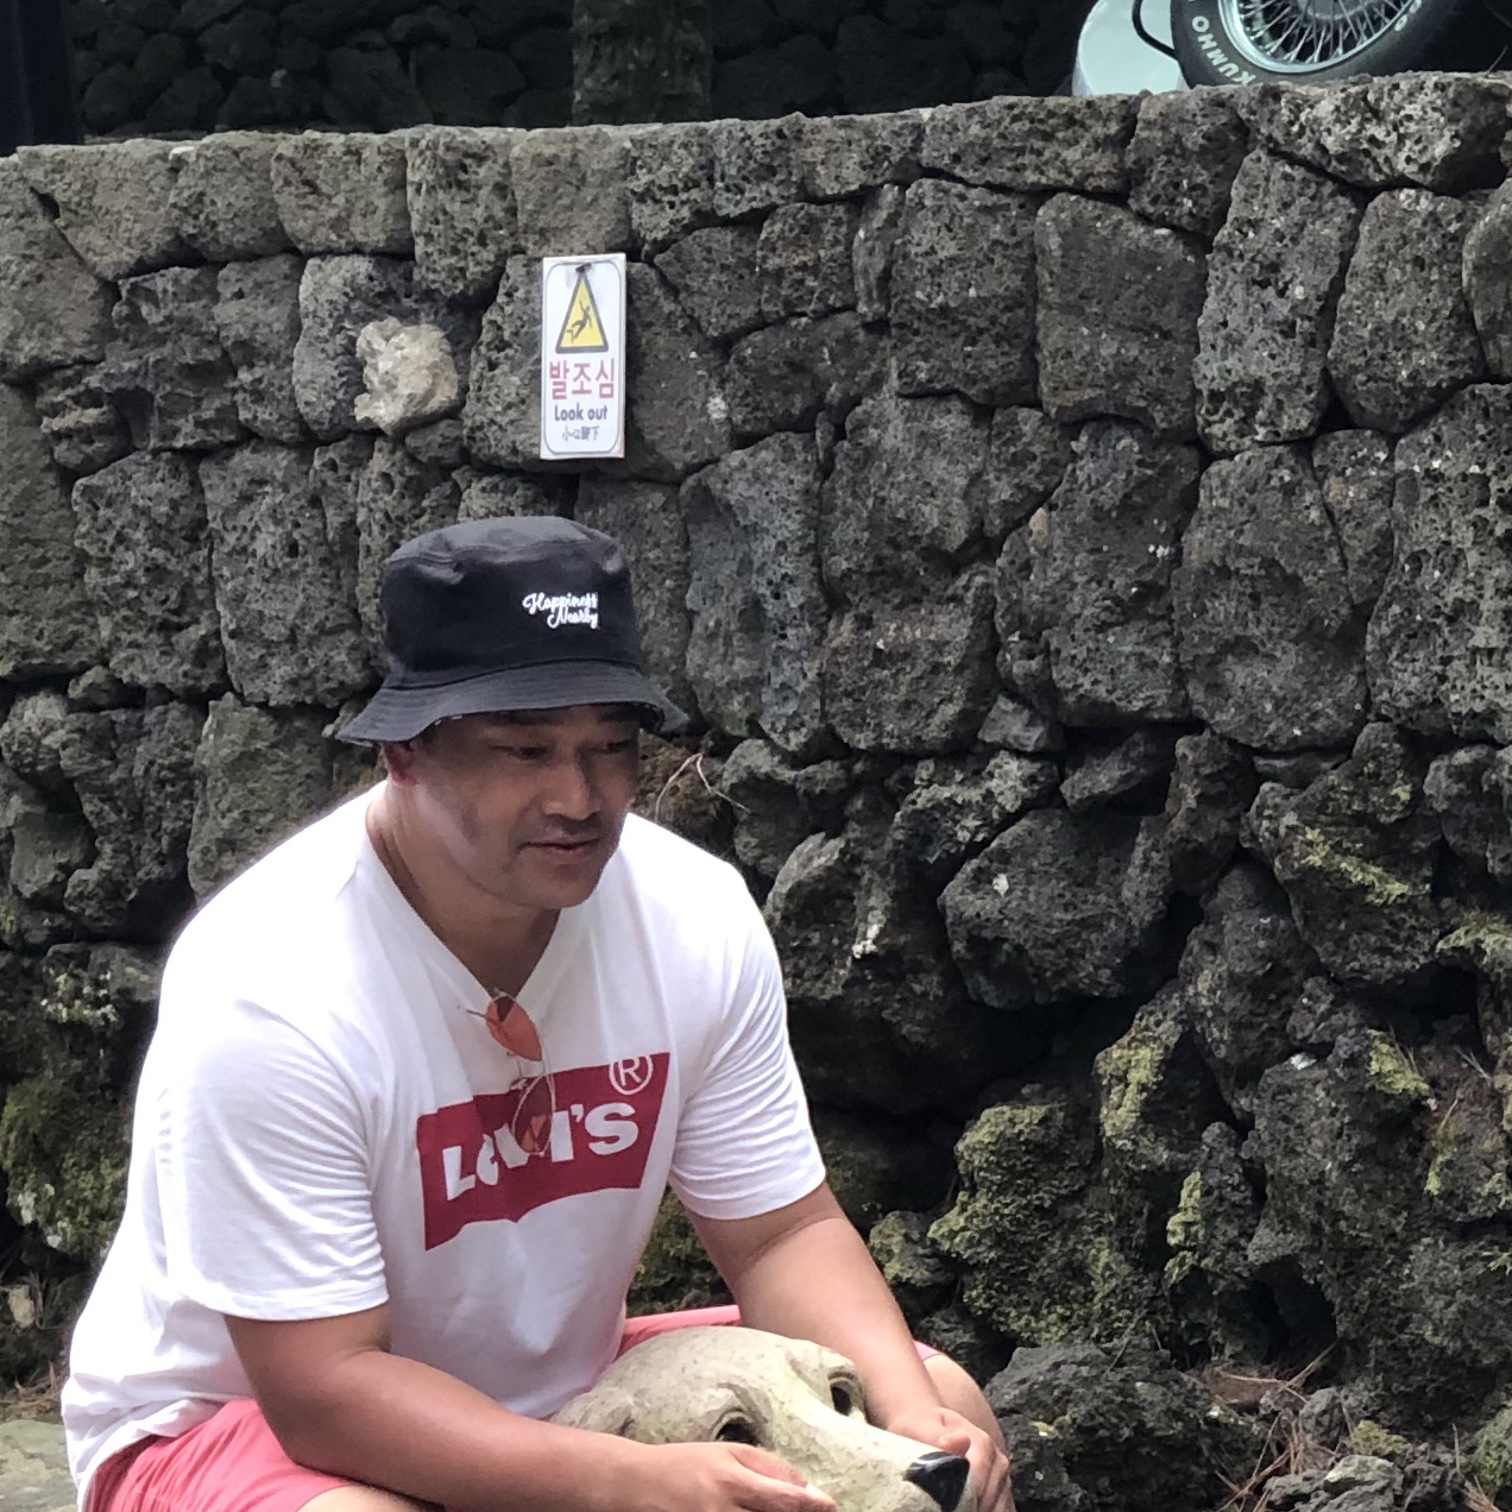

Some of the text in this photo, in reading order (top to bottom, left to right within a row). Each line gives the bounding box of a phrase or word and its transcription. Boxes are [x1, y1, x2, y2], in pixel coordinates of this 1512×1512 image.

[1191, 15, 1257, 86] KUMHO
[550, 358, 615, 400] 발조심
[554, 402, 608, 421] Look out
[522, 592, 598, 615] Happiness
